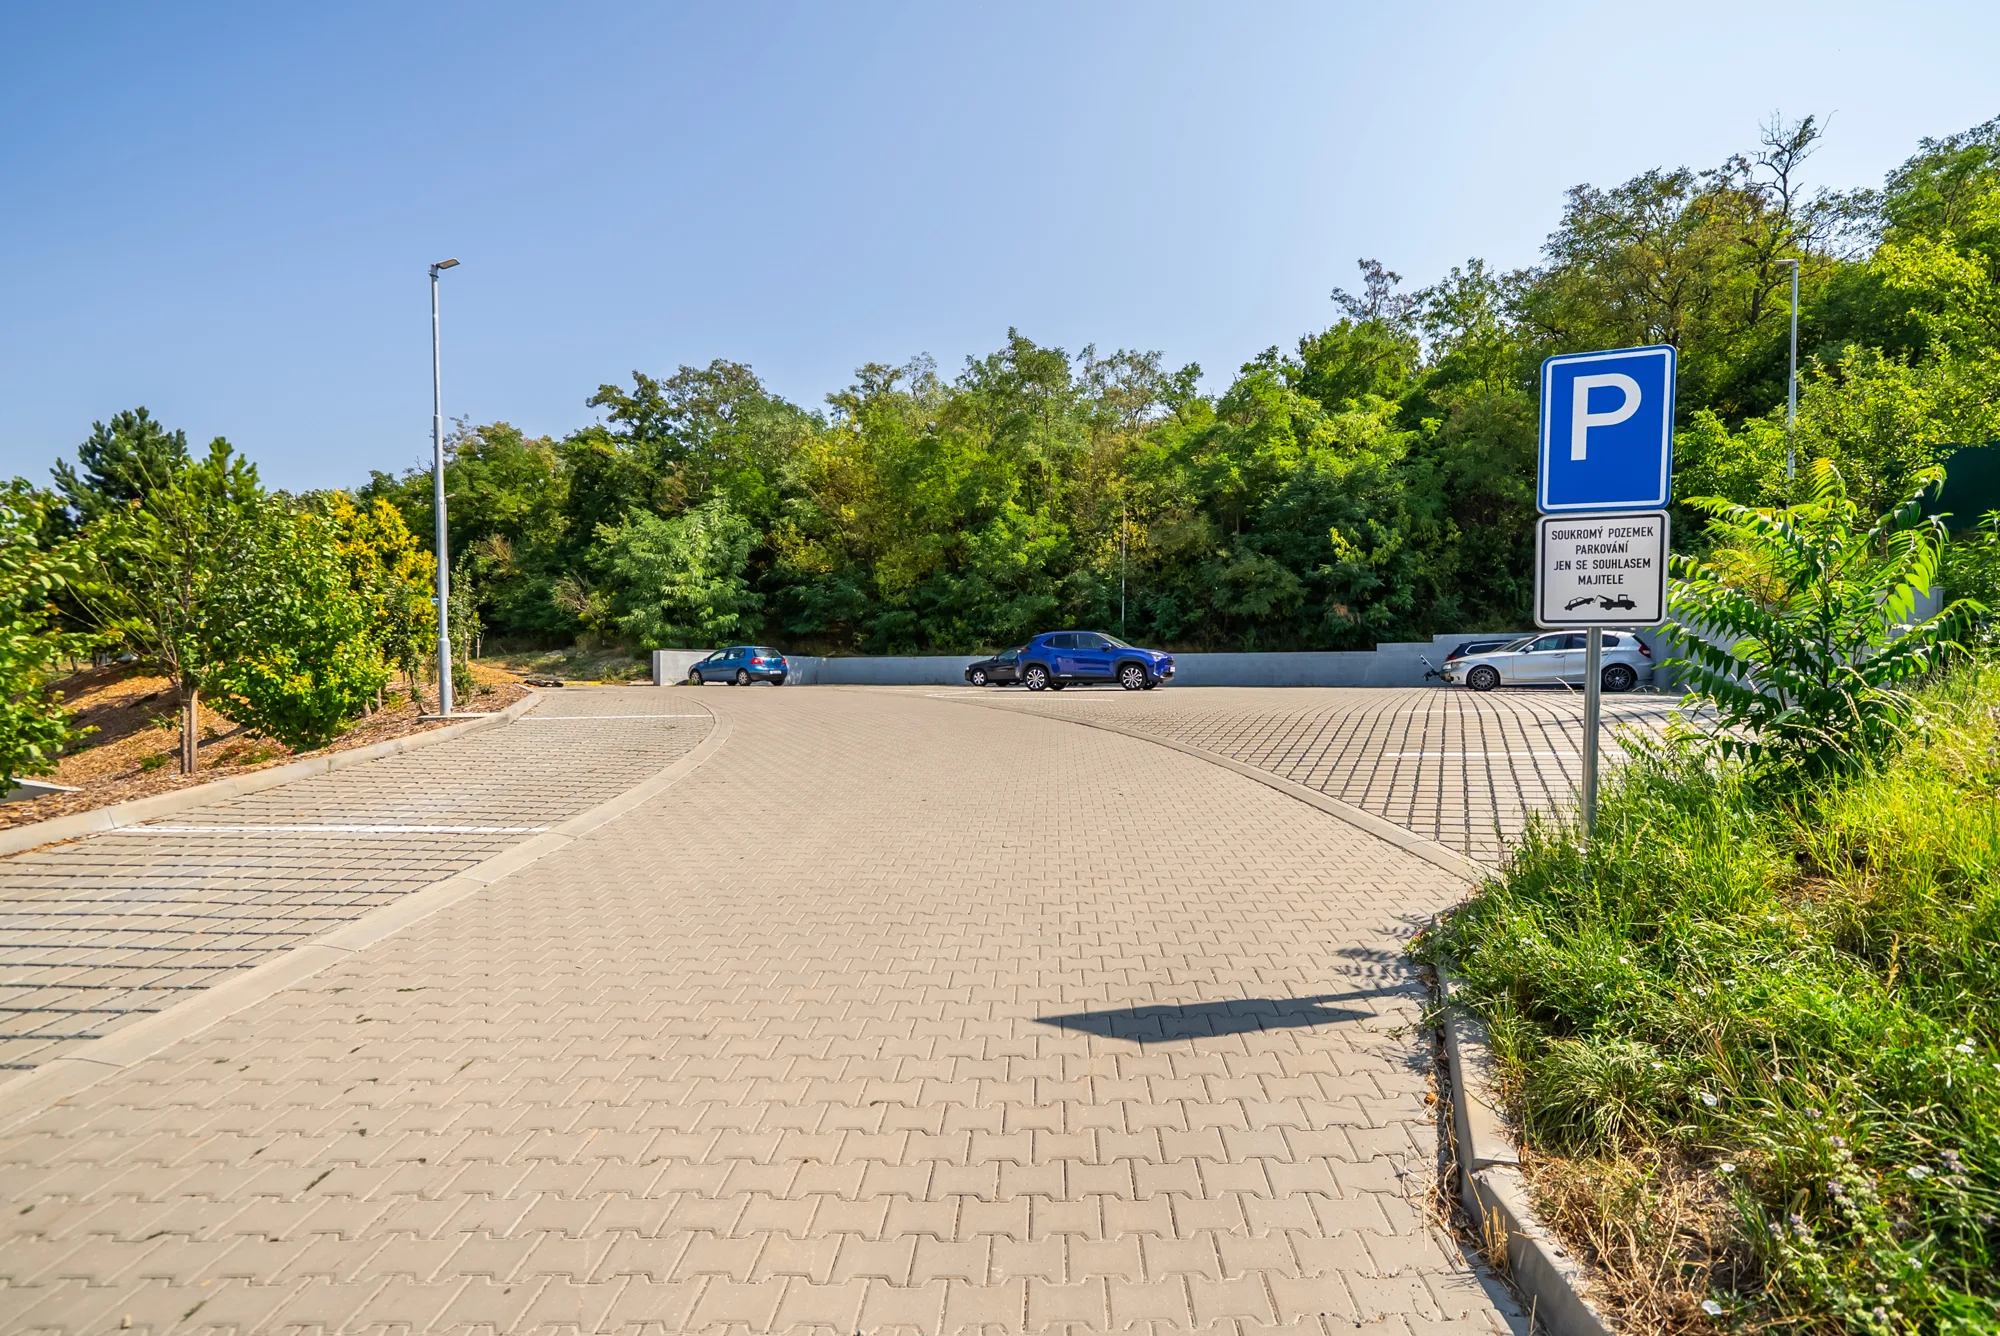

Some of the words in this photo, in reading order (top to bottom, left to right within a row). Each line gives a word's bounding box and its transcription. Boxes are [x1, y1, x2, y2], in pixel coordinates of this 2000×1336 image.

[1571, 373, 1642, 461] P
[1551, 525, 1603, 540] SOUKROMÝ
[1608, 526, 1654, 538] POZEMEK
[1575, 540, 1629, 554] PARKOVÁNÍ
[1553, 560, 1571, 570] JEN
[1576, 559, 1588, 570] SE
[1592, 558, 1651, 569] SOUHLASEM
[1578, 574, 1624, 585] MAJITELE
